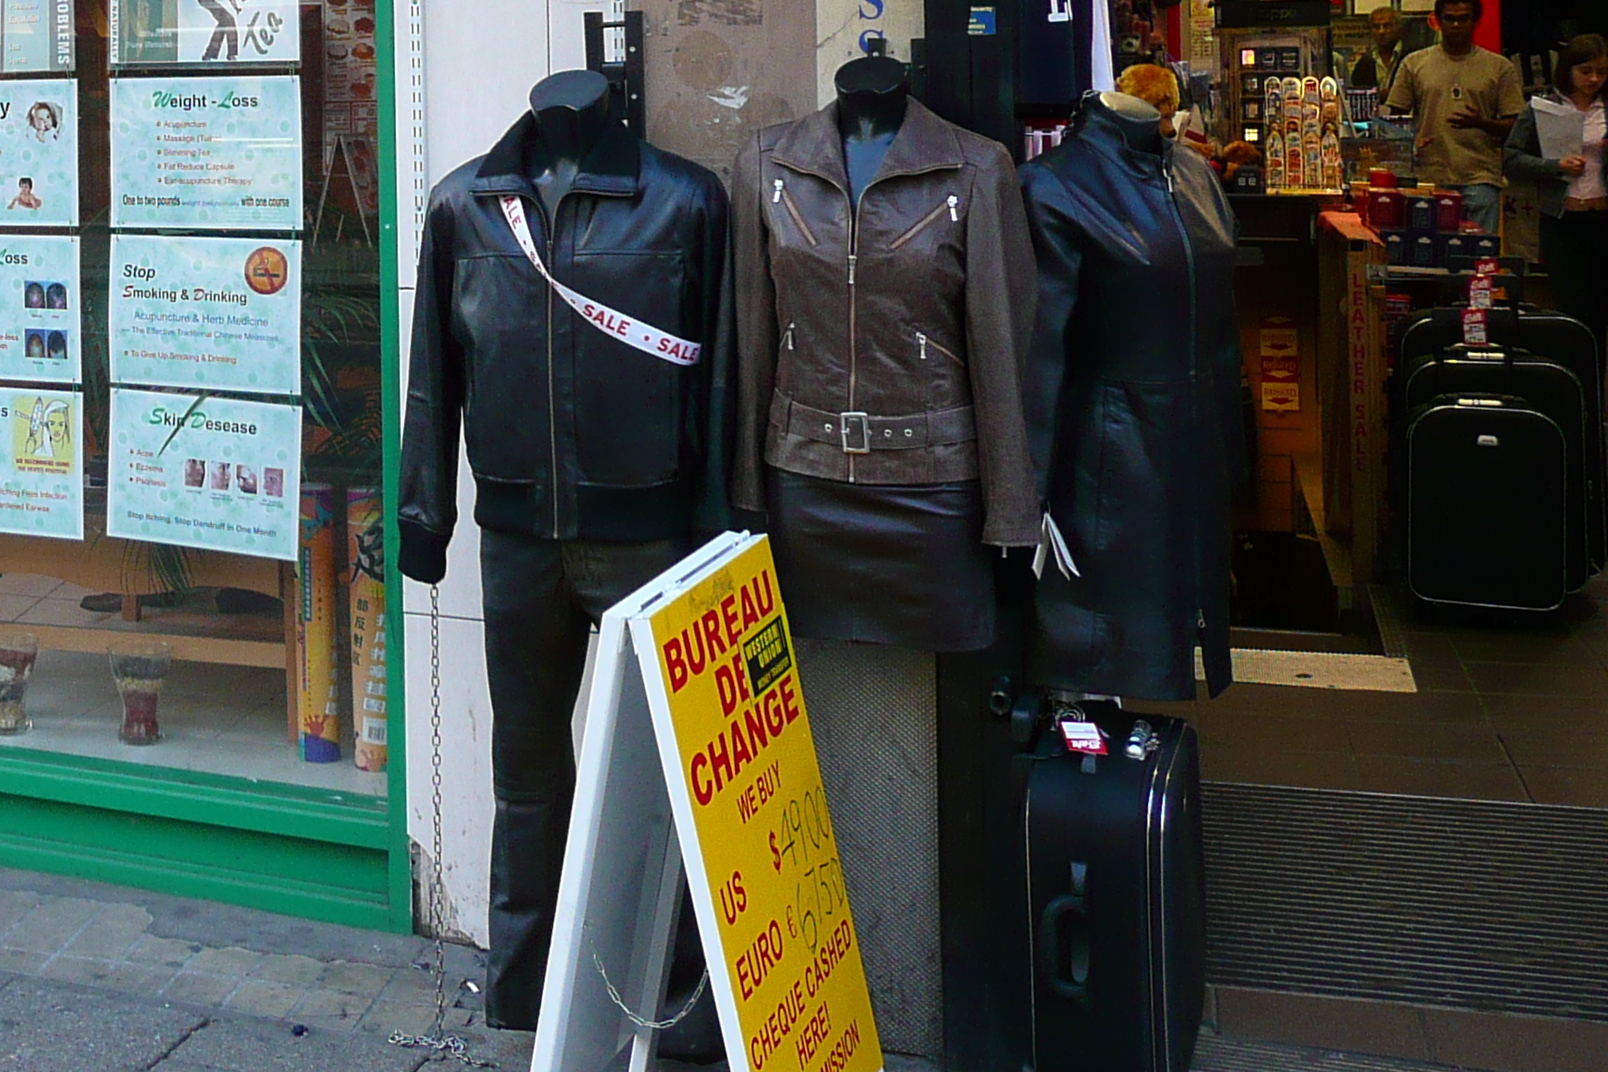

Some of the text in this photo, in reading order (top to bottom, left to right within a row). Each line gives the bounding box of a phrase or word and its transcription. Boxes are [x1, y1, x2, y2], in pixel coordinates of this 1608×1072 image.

[152, 91, 207, 111] Weight
[122, 285, 247, 306] Smoking & Drinking
[123, 264, 156, 281] Stop
[134, 311, 190, 323] Acupuncture
[202, 315, 225, 325] Herb
[227, 316, 268, 327] Medicine
[583, 304, 631, 337] SALE
[190, 411, 257, 435] Desease
[663, 570, 774, 693] BUREAU
[715, 651, 749, 718] DE
[691, 674, 799, 807] CHANGE
[737, 760, 780, 825] WE BUY
[719, 830, 782, 926] US $
[736, 920, 783, 1001] EURO
[750, 919, 852, 1071] CHEQUE CASHED
[796, 1001, 832, 1071] HERE!
